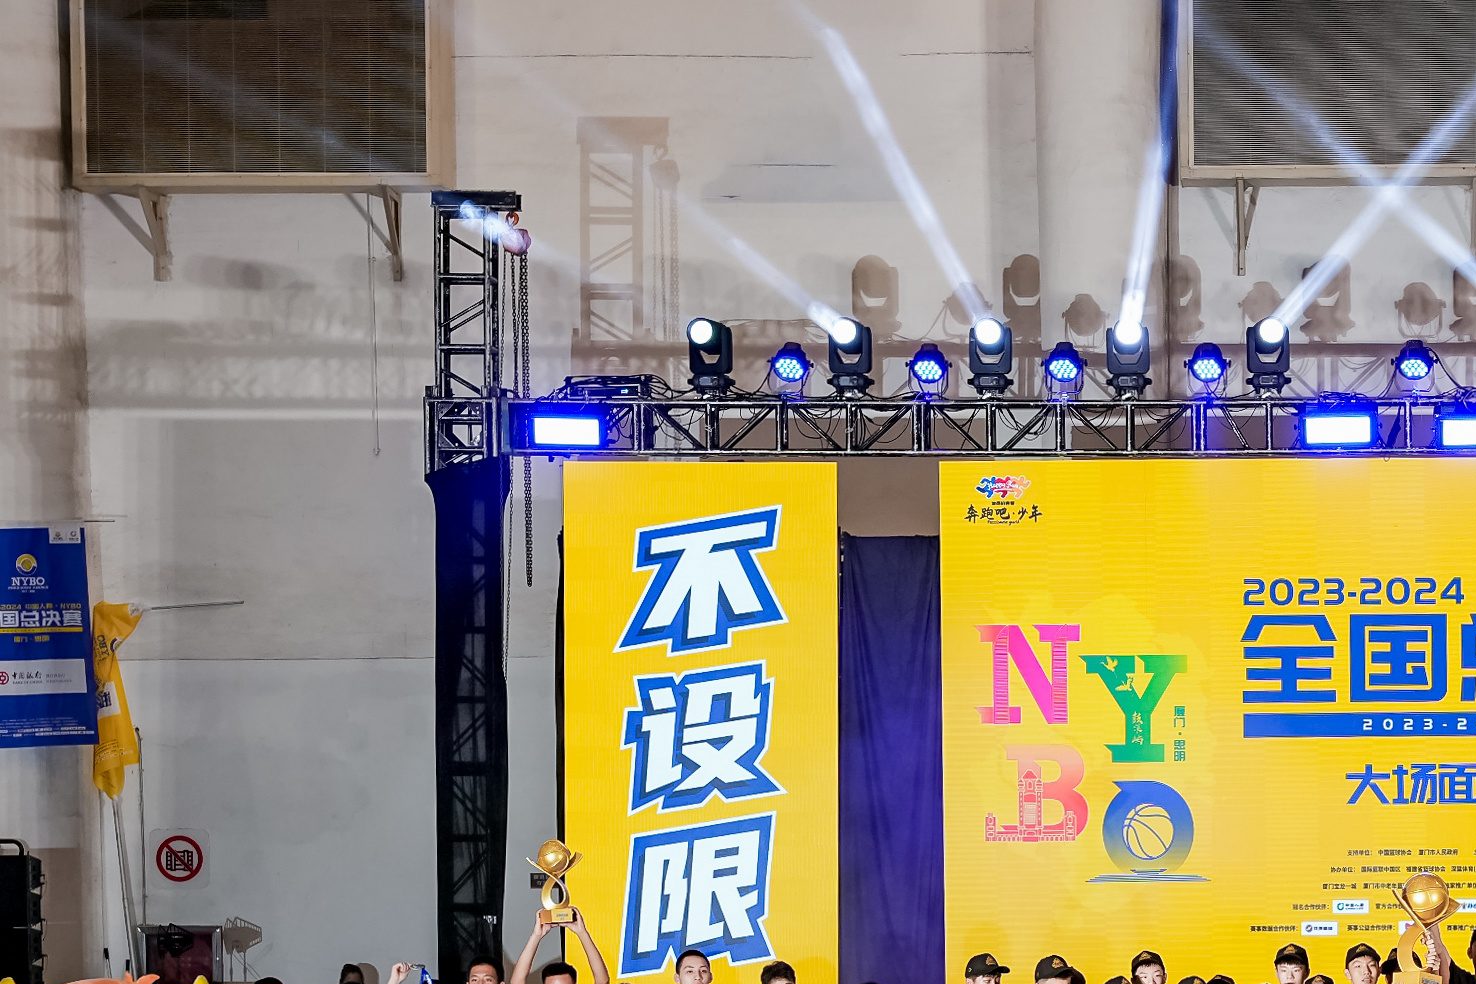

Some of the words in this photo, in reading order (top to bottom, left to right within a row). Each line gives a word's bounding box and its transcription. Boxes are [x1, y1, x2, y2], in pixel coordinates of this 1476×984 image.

[11, 576, 45, 586] NYBO
[1242, 577, 1466, 605] 2023-2024
[0, 610, 84, 628] 国总决赛
[613, 505, 789, 978] 不设限
[1418, 848, 1459, 856] 厦门市人民政府
